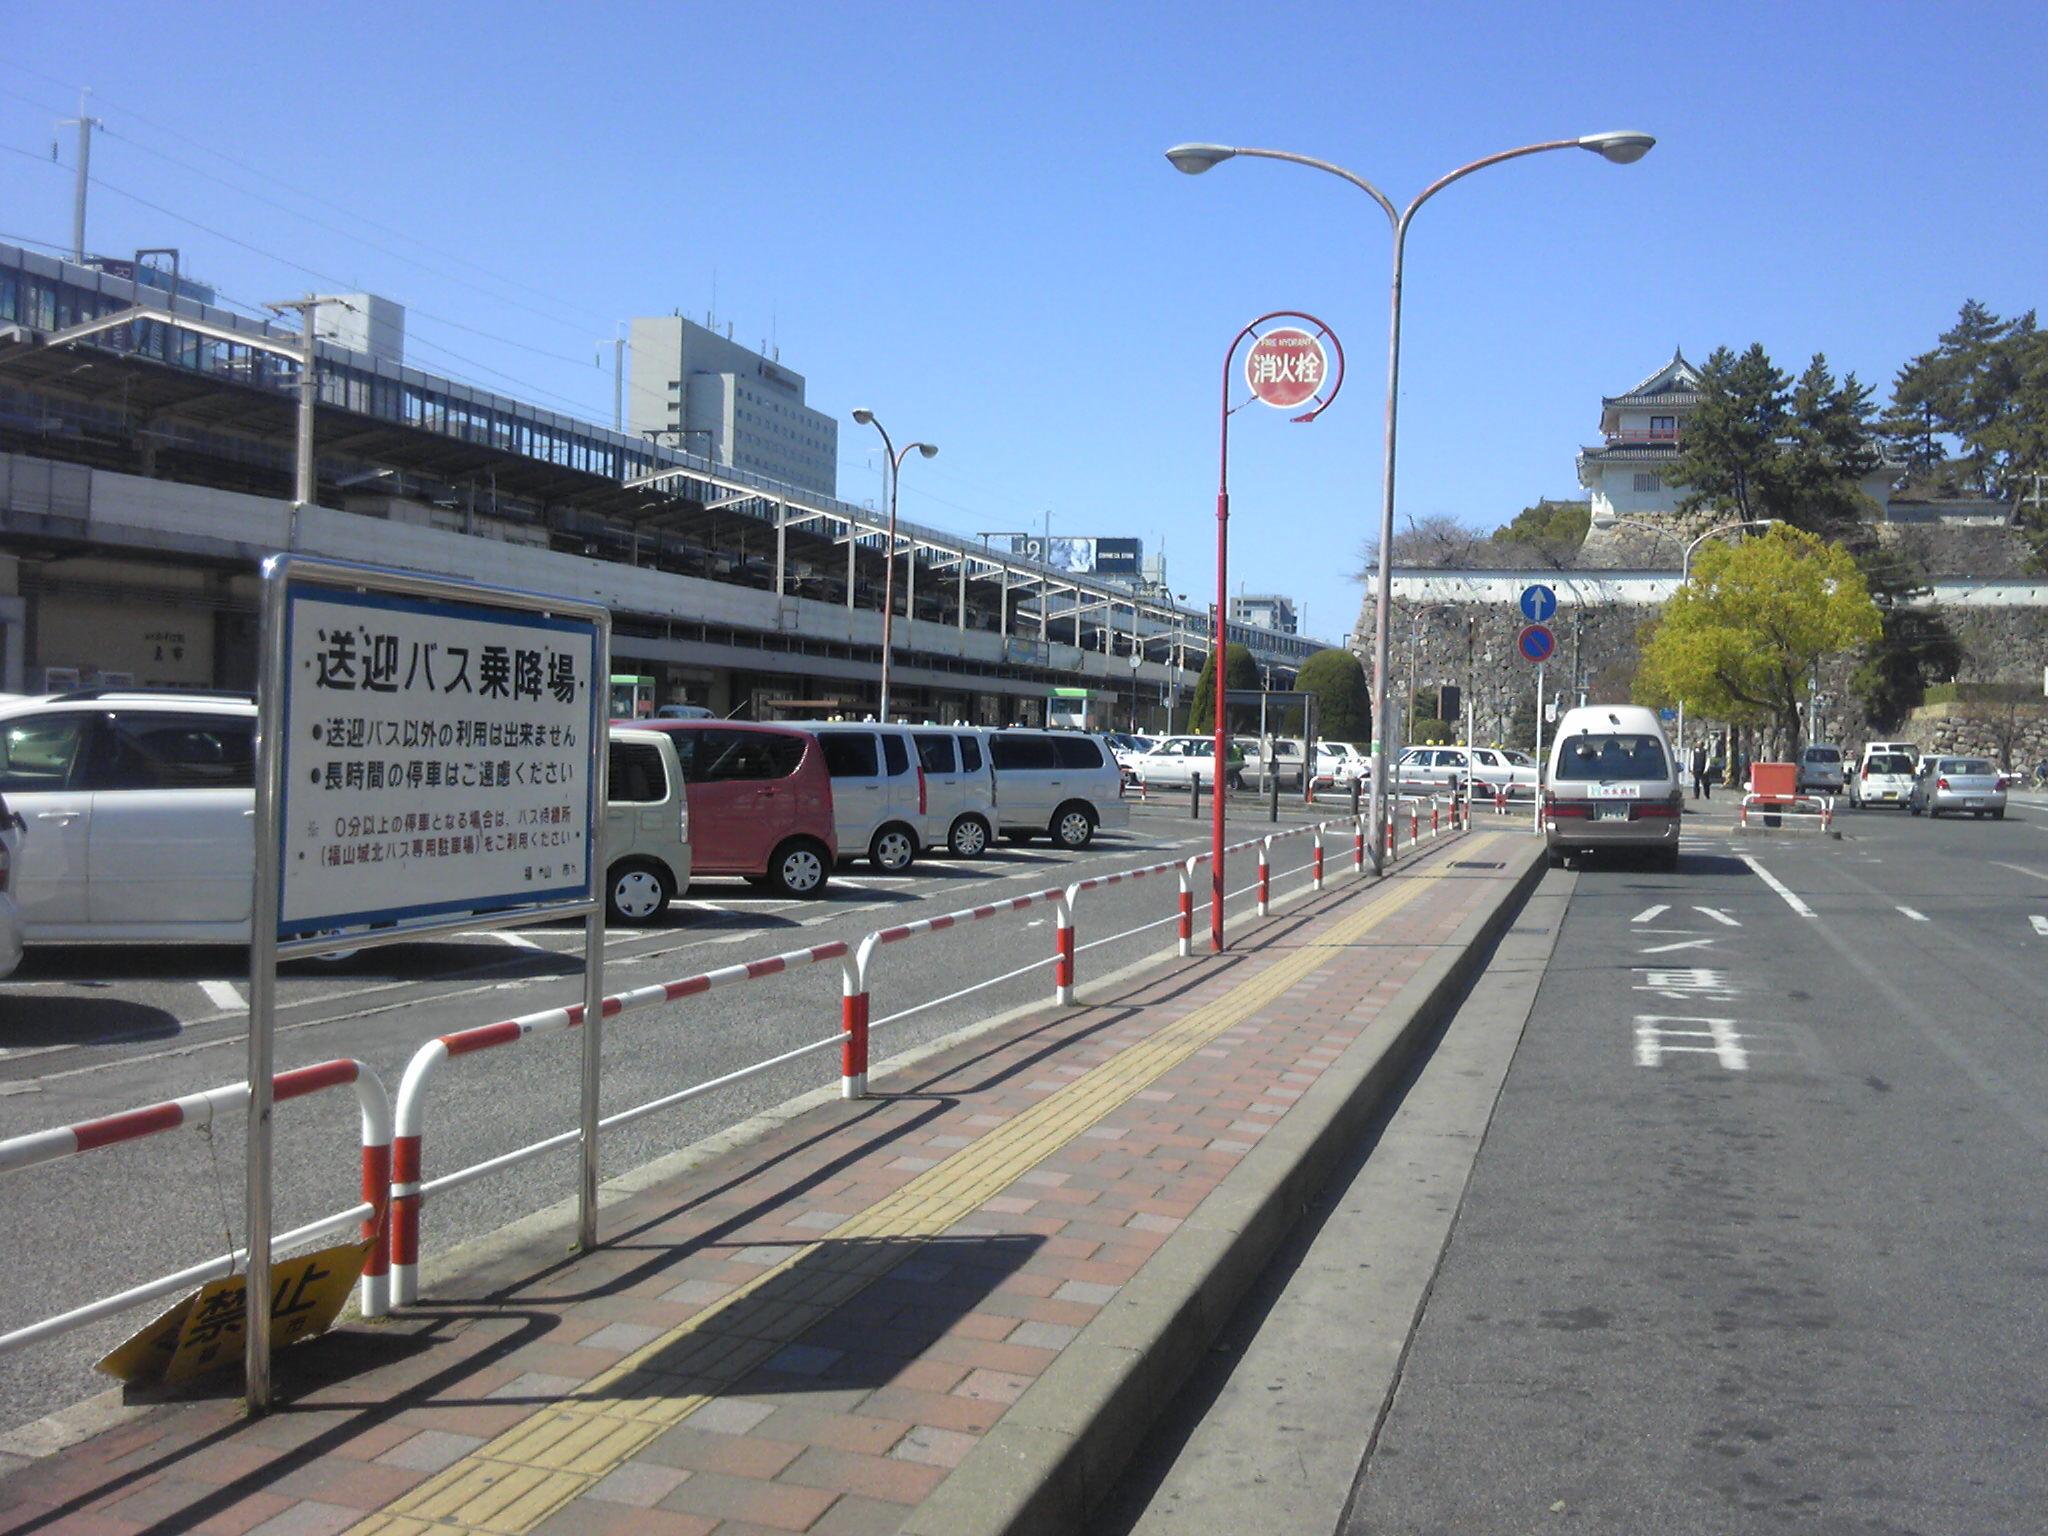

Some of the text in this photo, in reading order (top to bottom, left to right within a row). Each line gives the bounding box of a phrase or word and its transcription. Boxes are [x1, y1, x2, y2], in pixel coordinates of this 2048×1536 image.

[1253, 351, 1320, 384] 消火栓
[316, 628, 576, 704] 送迎バス乗降場
[326, 717, 576, 748] 送迎バス以外の利用は出来ません
[325, 760, 574, 791] 長時間の停車はご遠慮ください
